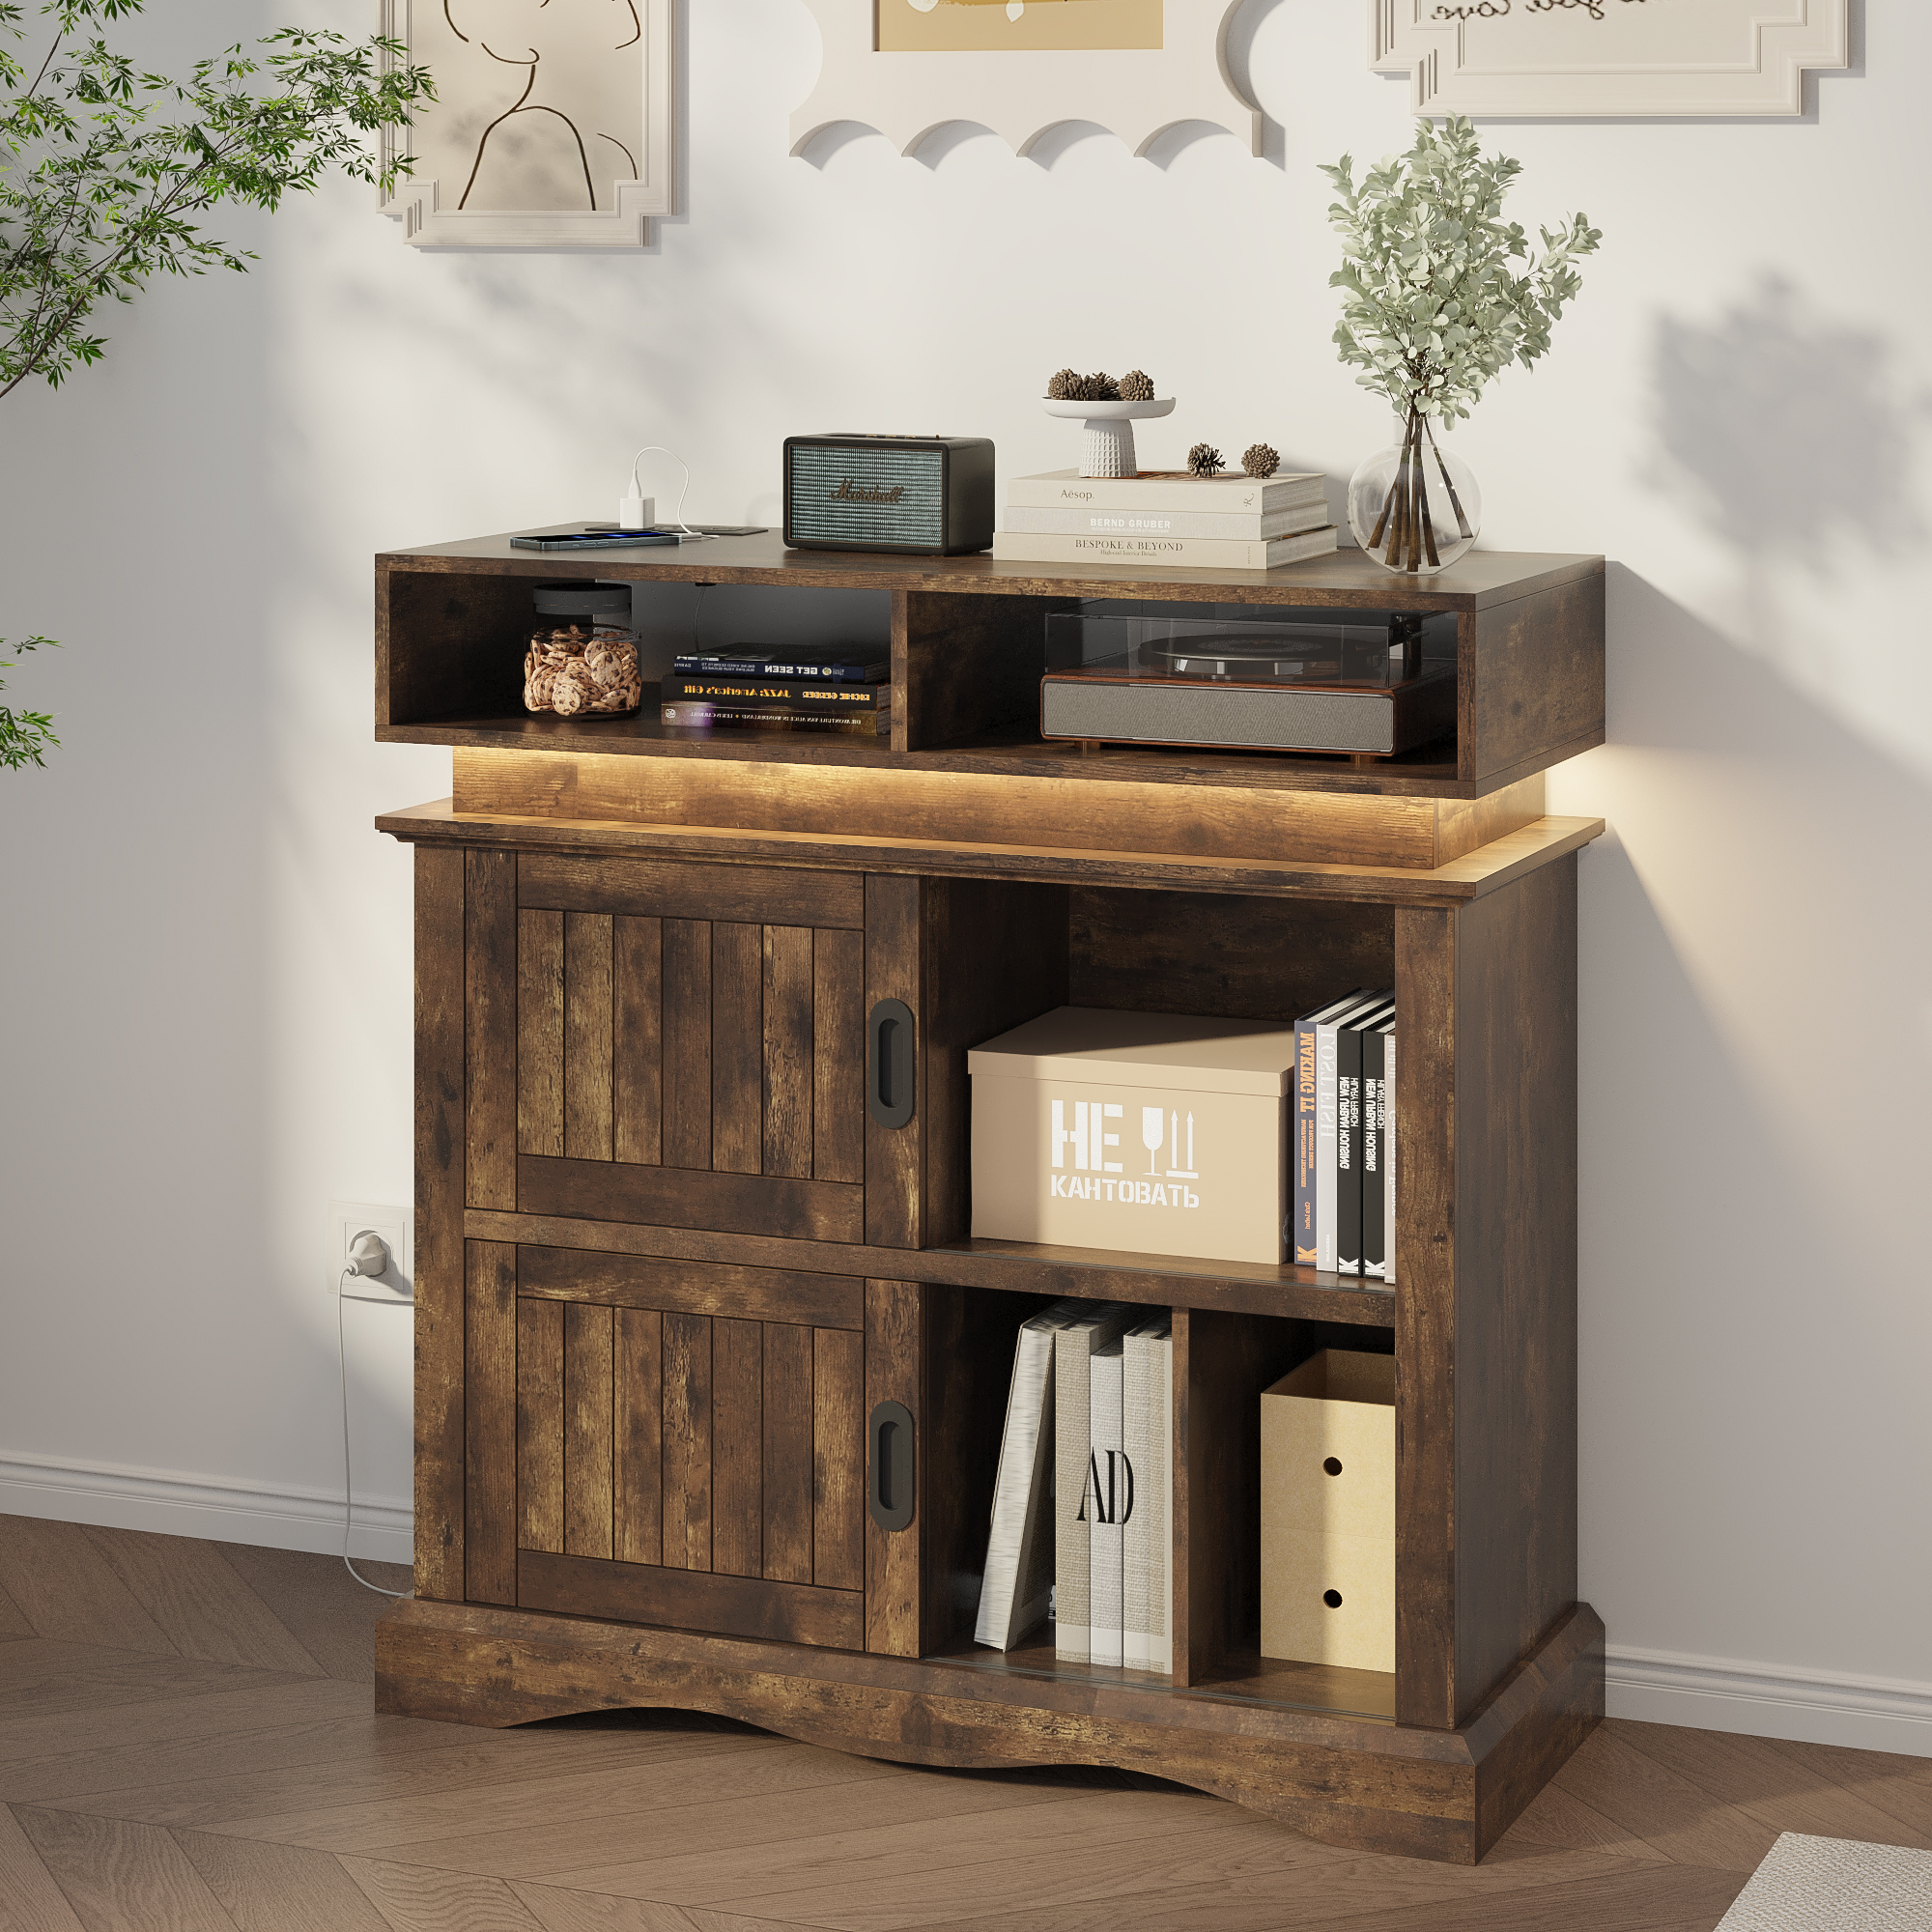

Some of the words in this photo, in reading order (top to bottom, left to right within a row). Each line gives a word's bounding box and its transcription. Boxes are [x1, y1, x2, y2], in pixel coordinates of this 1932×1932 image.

[830, 478, 904, 502] Marshall
[1090, 518, 1124, 527] BERND
[1128, 519, 1171, 528] GRUBER
[1075, 539, 1123, 550] BESPOKE
[1126, 541, 1133, 550] &
[1138, 541, 1183, 552] BEYOND
[1051, 1099, 1123, 1173] НЕ
[1051, 1174, 1200, 1208] КАНТОВАТЬ
[1076, 1446, 1134, 1525] AD
